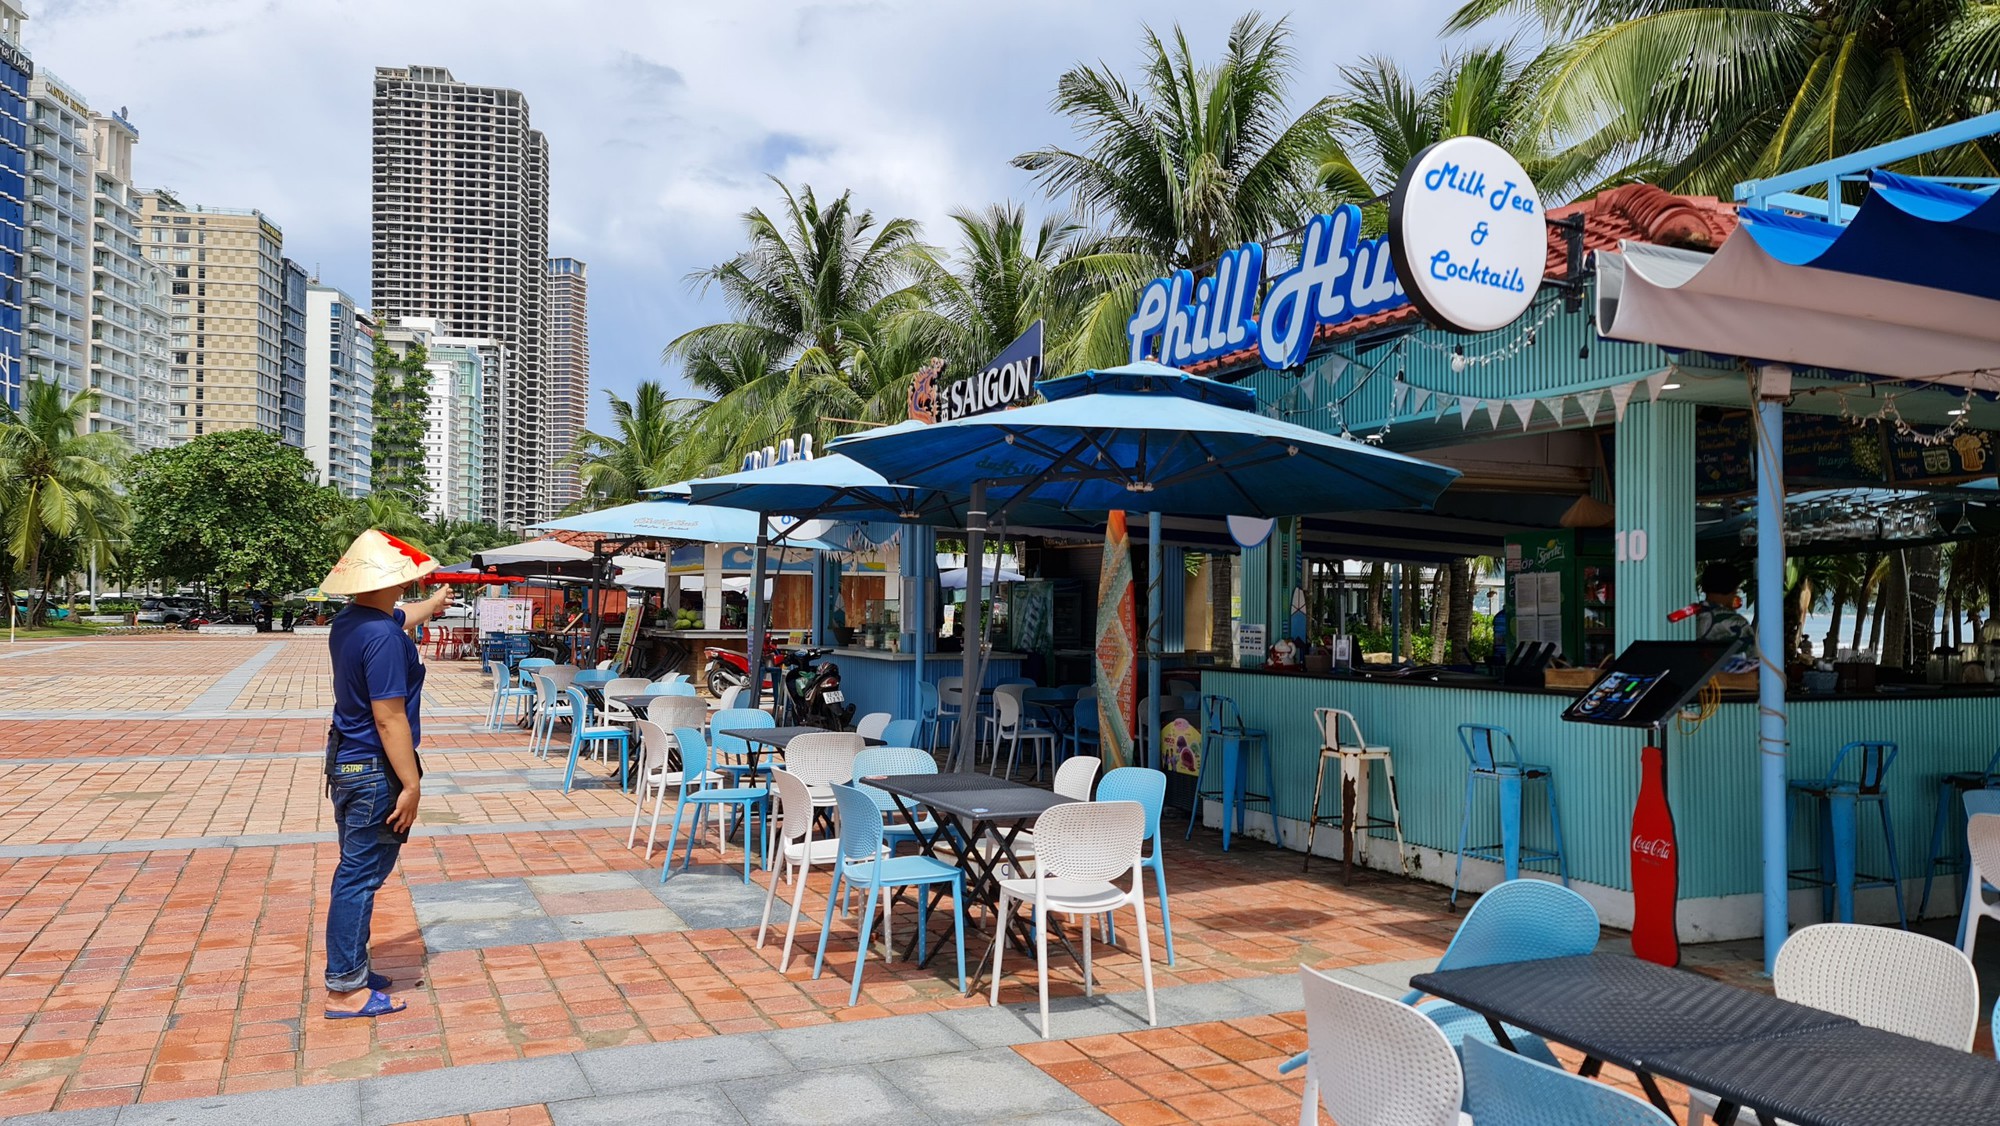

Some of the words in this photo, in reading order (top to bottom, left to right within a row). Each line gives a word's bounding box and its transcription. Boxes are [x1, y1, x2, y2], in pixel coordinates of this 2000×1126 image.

[45, 81, 69, 106] CANVAS
[69, 97, 89, 120] HOTEL
[1424, 161, 1487, 198] Milk
[1489, 180, 1535, 214] Tea
[1470, 221, 1489, 246] &
[1258, 204, 1410, 370] Hu
[1429, 249, 1526, 293] Cocktails
[951, 355, 1033, 420] SAIGON
[1538, 545, 1563, 564] Sprite
[1615, 529, 1648, 562] 10
[341, 764, 363, 773] G-STAR
